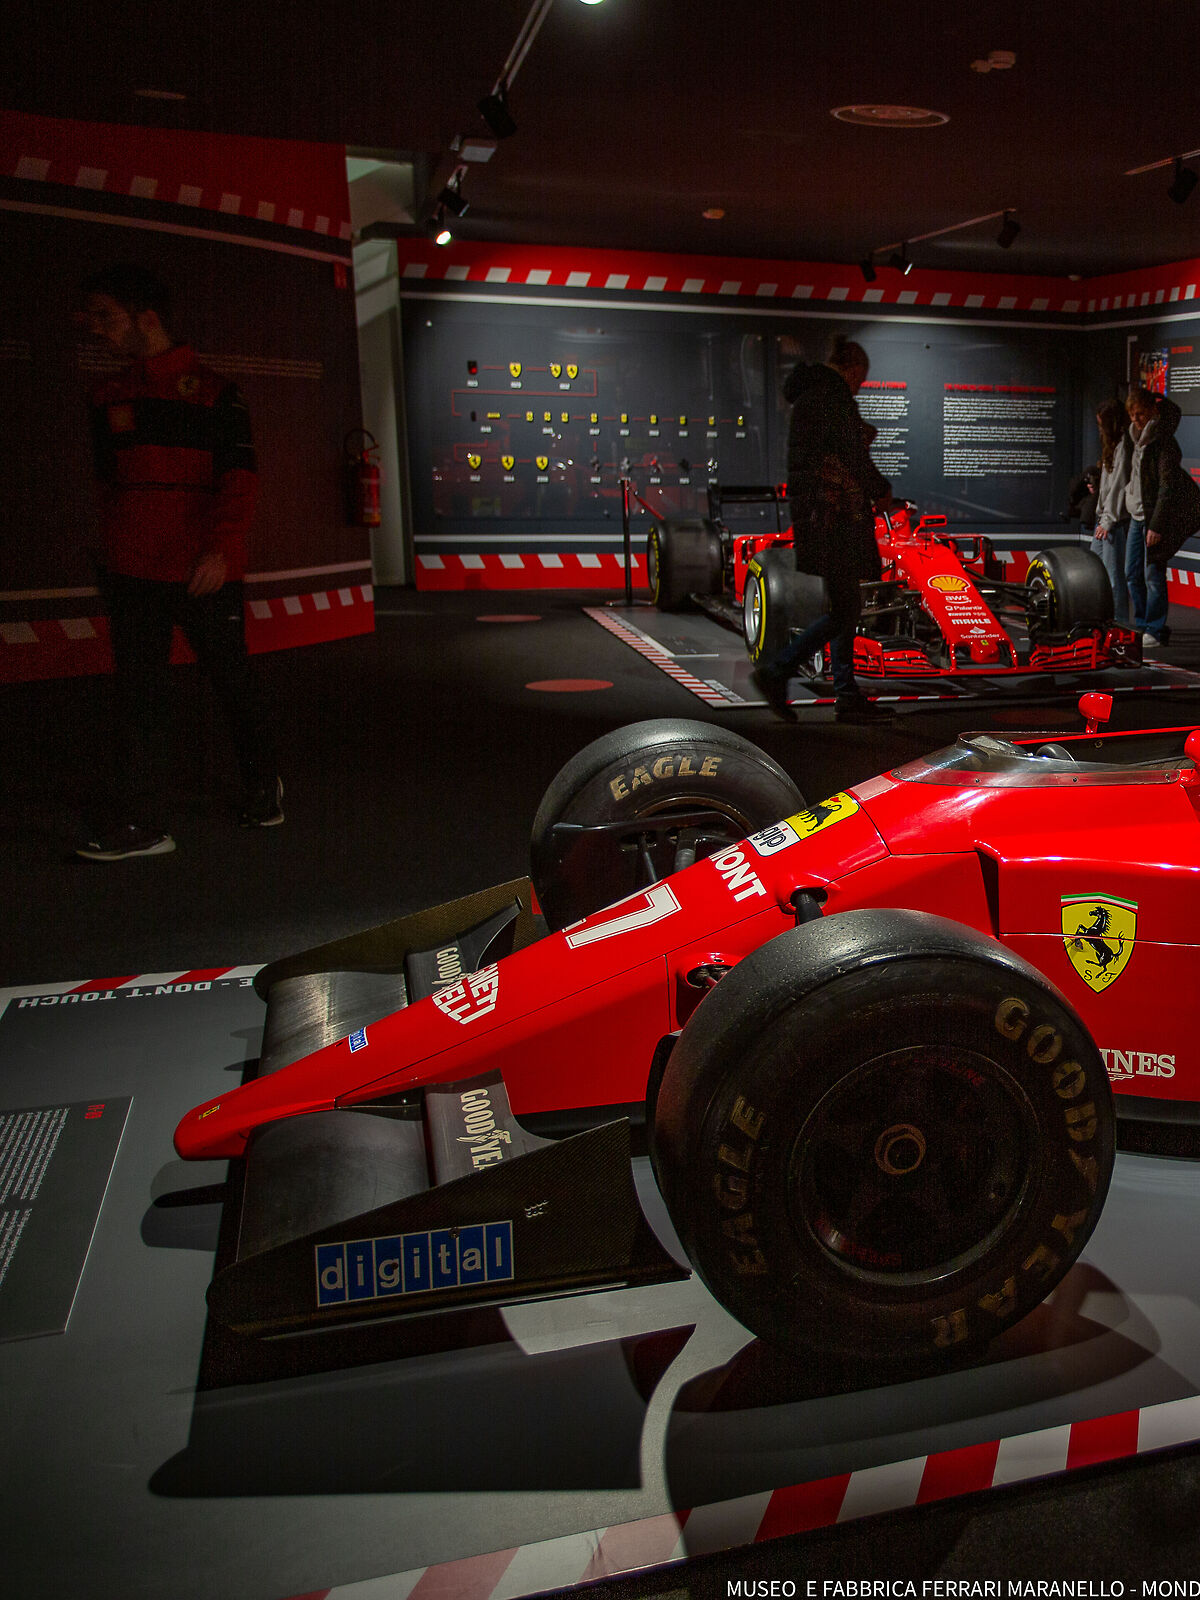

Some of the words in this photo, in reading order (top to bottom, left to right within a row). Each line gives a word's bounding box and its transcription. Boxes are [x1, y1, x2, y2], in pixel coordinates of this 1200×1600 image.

[609, 756, 723, 801] EAGLE
[562, 883, 683, 950] 7
[18, 989, 117, 1009] TOUCH
[126, 981, 212, 999] DON'T
[1099, 1047, 1176, 1078] INES
[713, 1094, 767, 1278] EAGLE
[929, 995, 1099, 1349] GOODYEAR
[320, 1237, 504, 1291] digital
